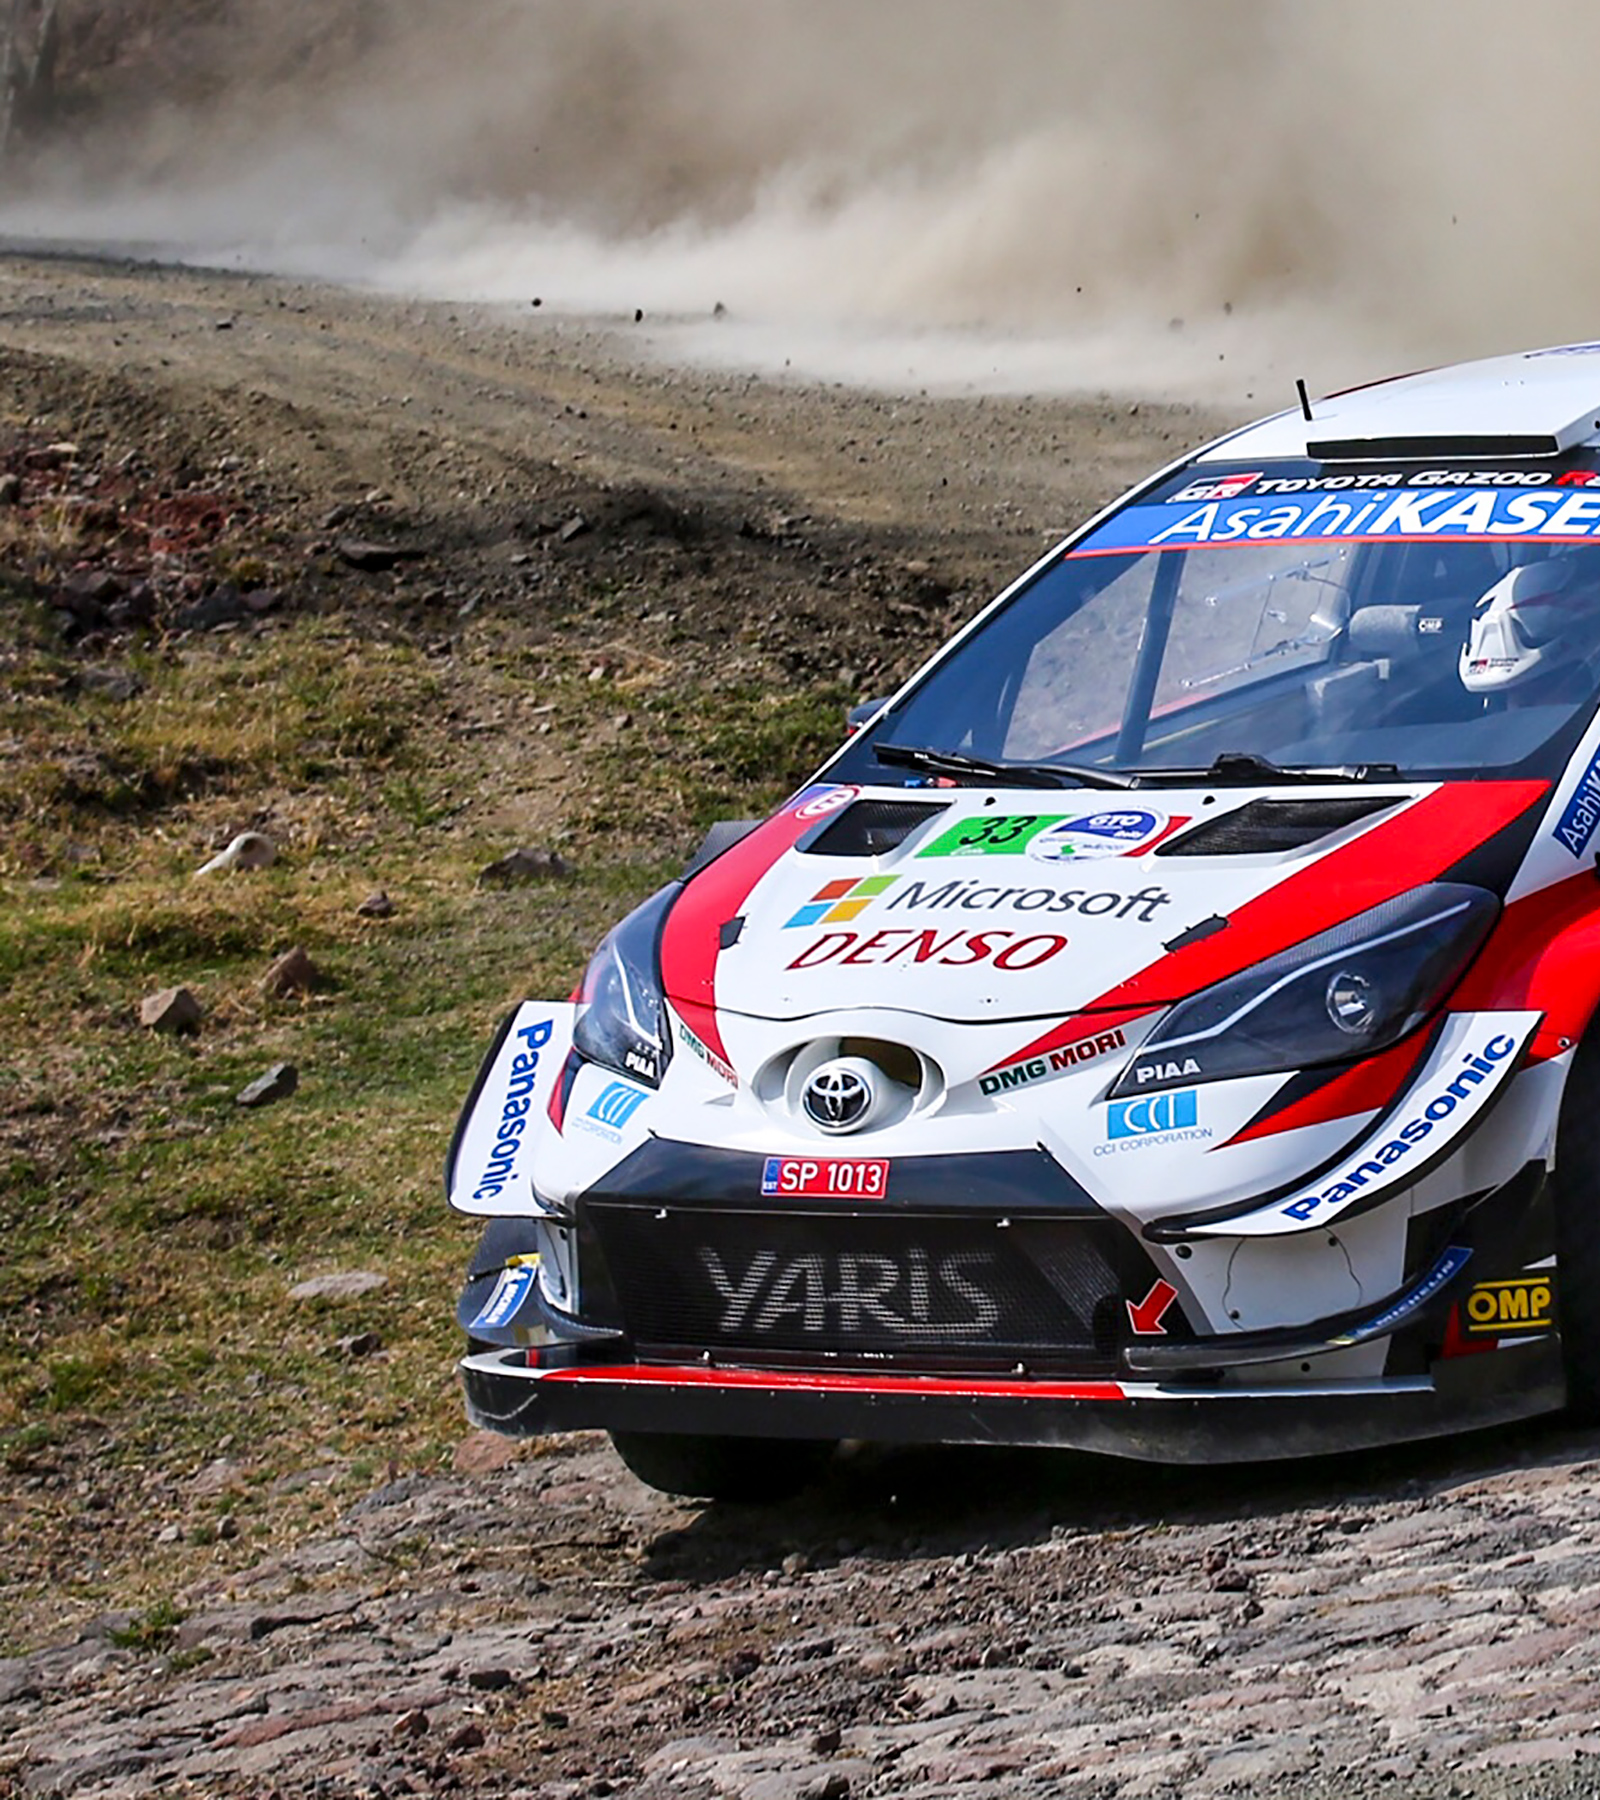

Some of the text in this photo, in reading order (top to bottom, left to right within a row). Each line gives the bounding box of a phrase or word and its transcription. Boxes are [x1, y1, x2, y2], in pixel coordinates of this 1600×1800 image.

[1256, 474, 1402, 494] TOYOTA
[1407, 470, 1552, 486] GAZOO
[958, 815, 1038, 846] 33
[1088, 814, 1143, 827] GTO
[886, 879, 1171, 923] Microsoft
[784, 929, 1068, 971] DENSO
[625, 1051, 656, 1079] PIAA
[678, 1022, 739, 1091] DMG MORI
[978, 1029, 1127, 1096] DMG MORI
[1136, 1058, 1201, 1084] PIAA
[473, 1019, 554, 1201] Panasonic
[1123, 1094, 1176, 1133] CCI
[1280, 1031, 1517, 1222] Panasonic
[1093, 1128, 1213, 1157] CCI CORPORATION
[781, 1162, 882, 1193] SP 1013
[1467, 1285, 1551, 1321] OMP
